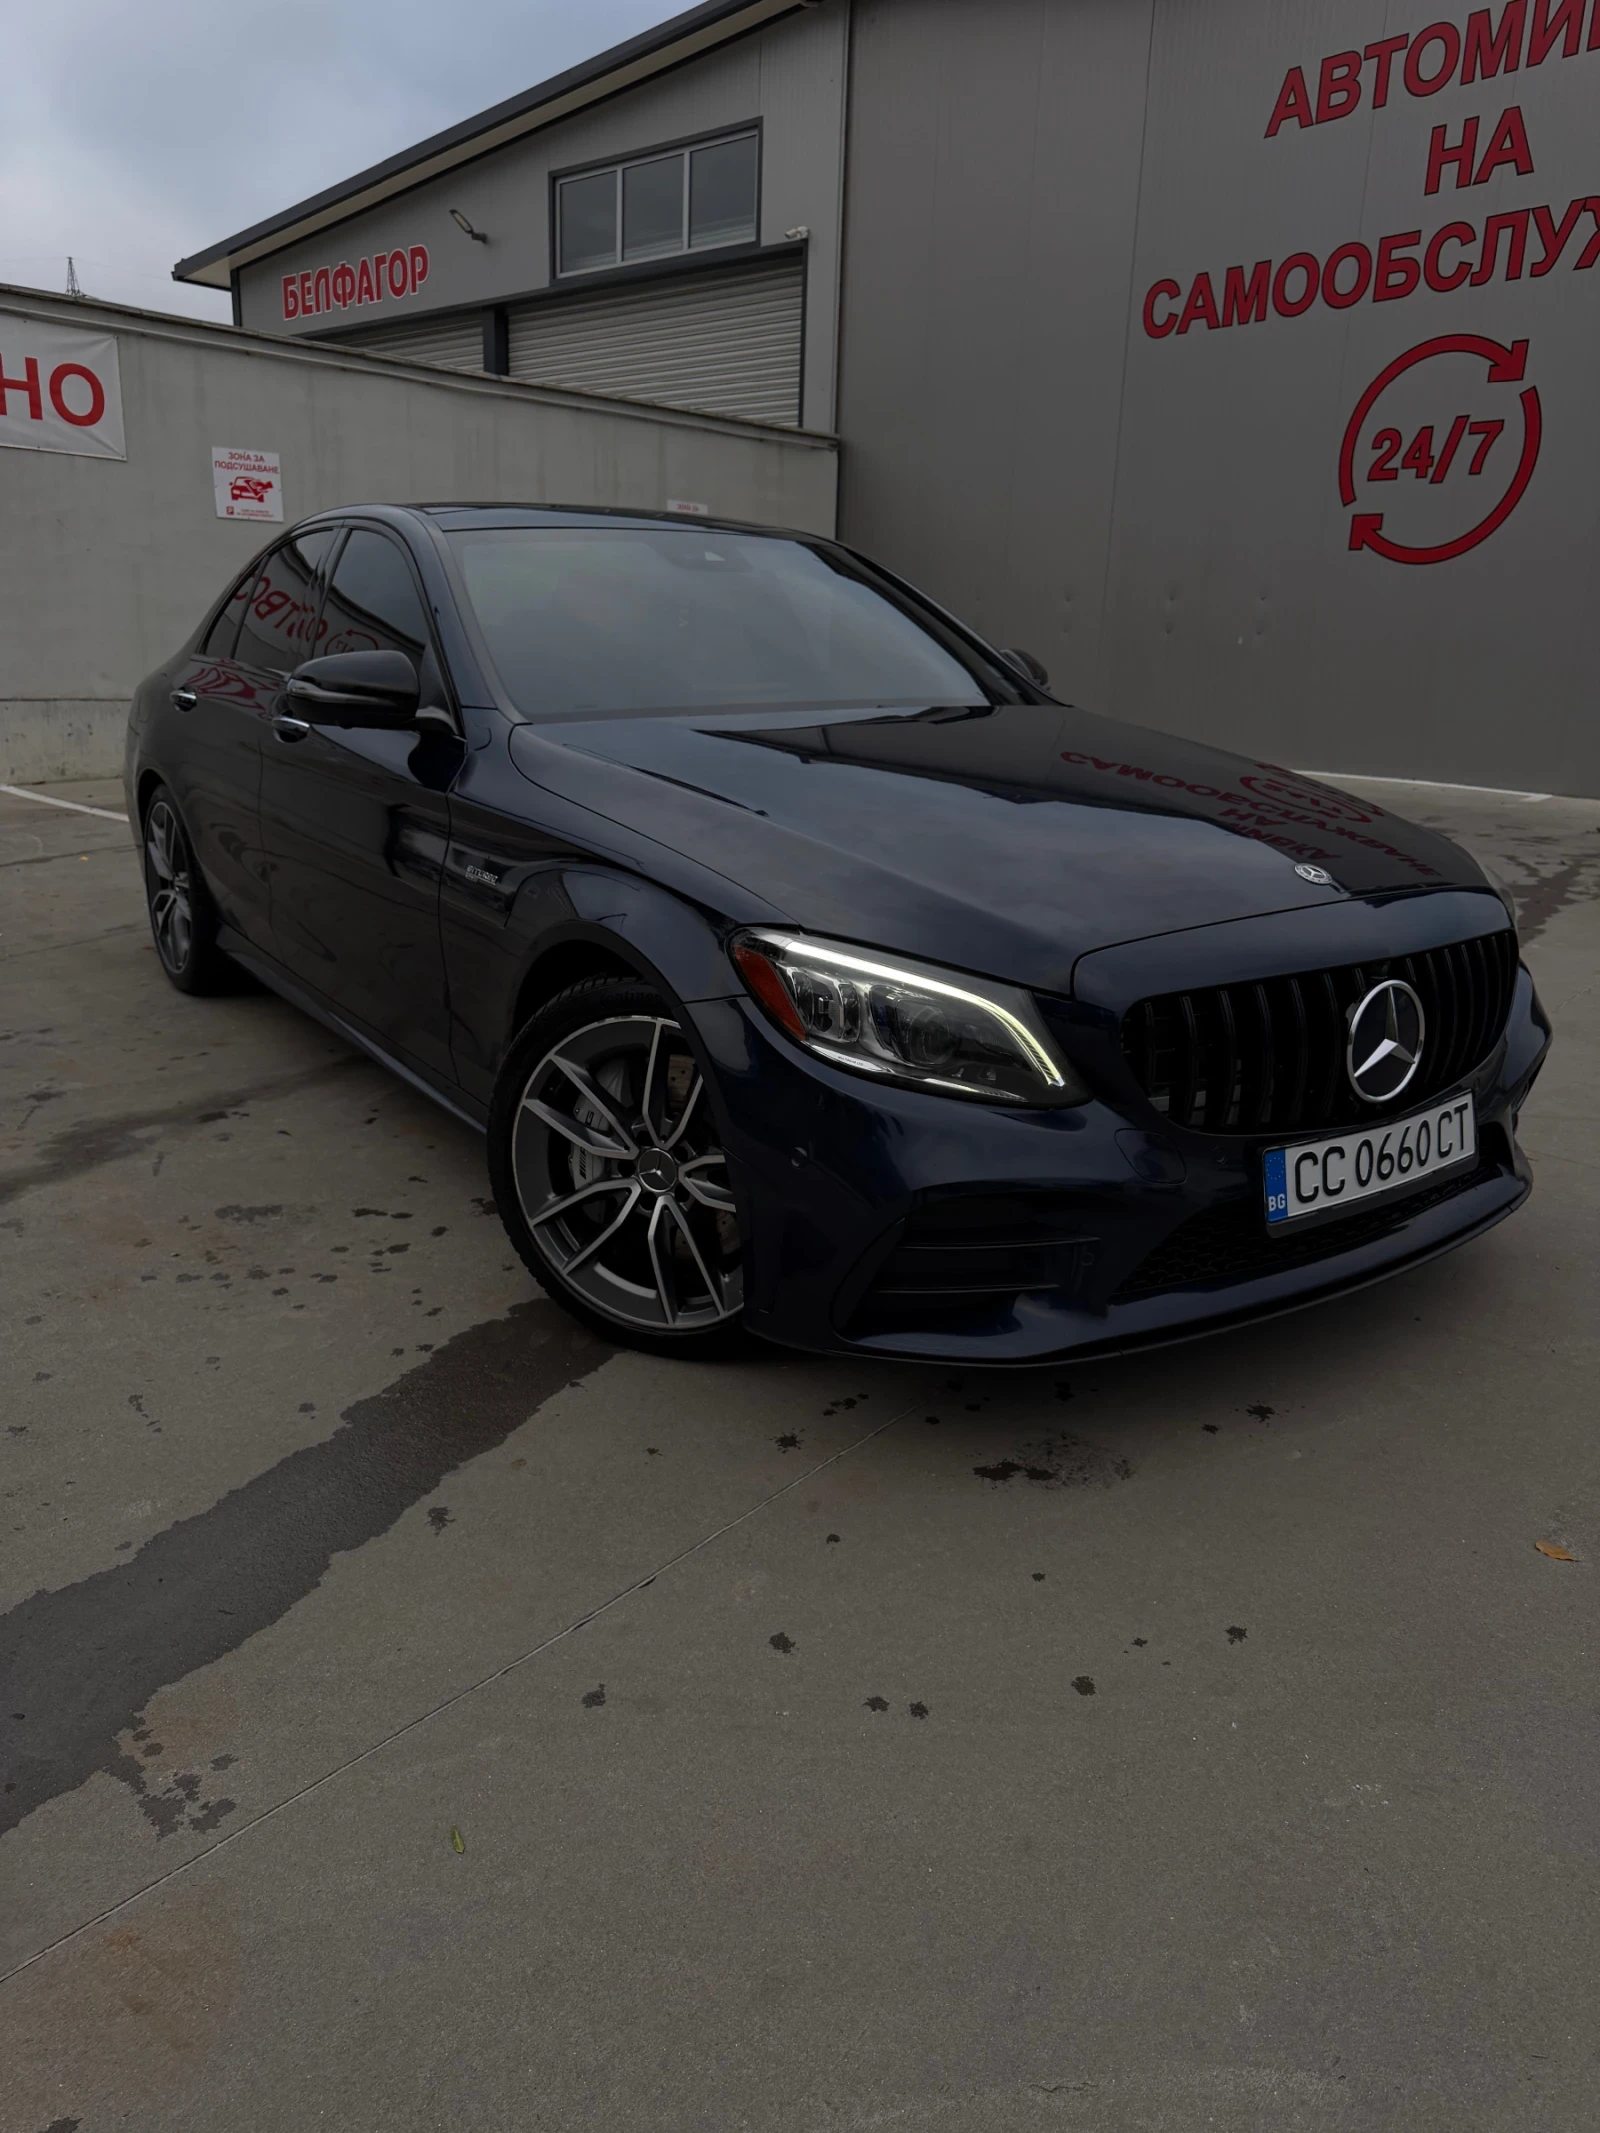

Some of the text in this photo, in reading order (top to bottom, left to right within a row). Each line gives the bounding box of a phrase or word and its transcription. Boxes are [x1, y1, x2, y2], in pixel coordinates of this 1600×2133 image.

[1264, 0, 1600, 138] АВТОМИ
[1424, 105, 1534, 196] НА
[282, 244, 429, 321] БЕЛФАГОР
[0, 352, 105, 427] НО
[214, 460, 279, 475] ПОДСУШАВАНЕ
[228, 452, 265, 463] ЗОНА ЗА
[1367, 415, 1504, 484] 24/7
[1267, 1193, 1286, 1212] BG
